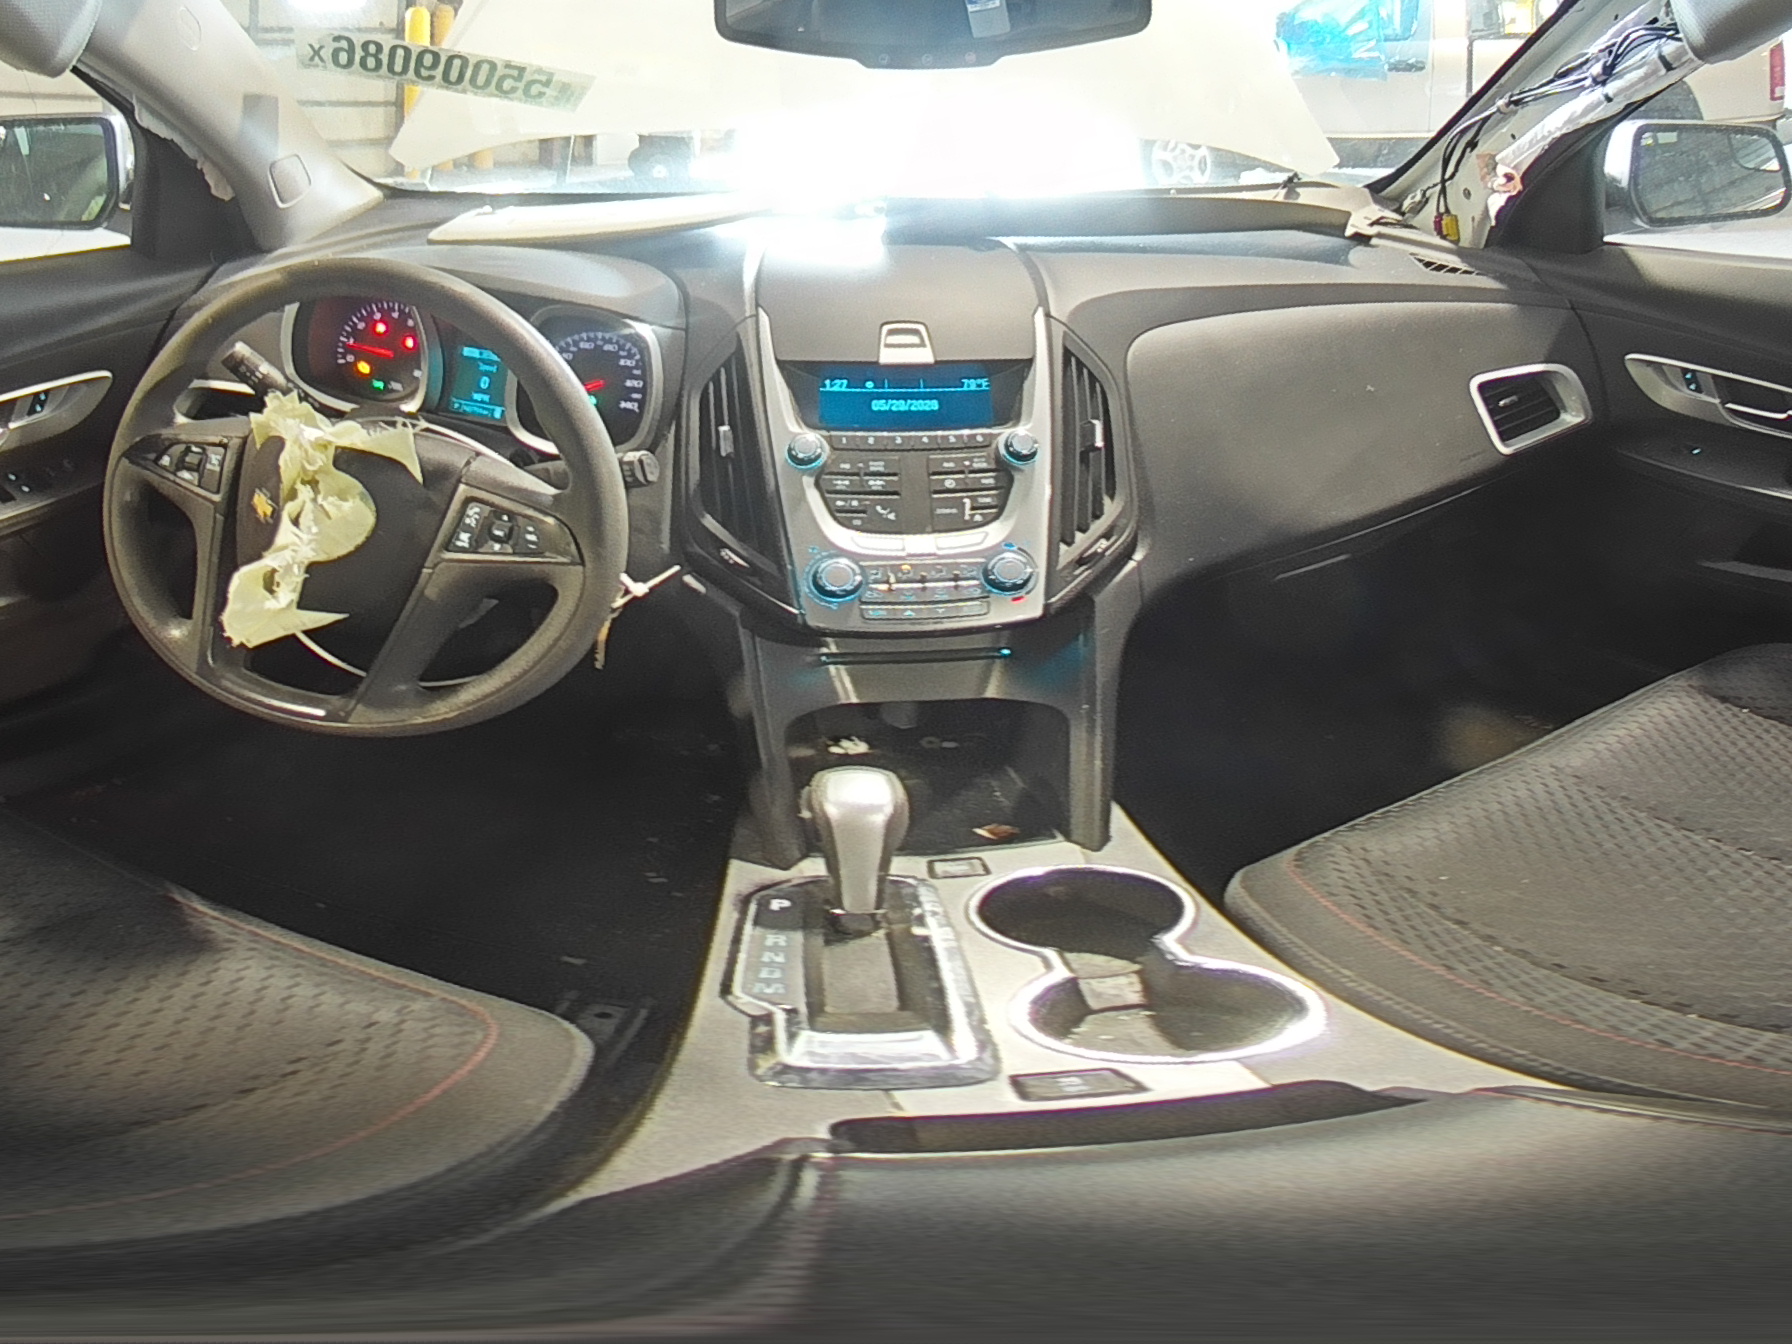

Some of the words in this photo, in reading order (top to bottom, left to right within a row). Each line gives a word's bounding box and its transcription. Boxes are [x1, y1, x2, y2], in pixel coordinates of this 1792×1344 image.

[480, 376, 490, 389] 0
[769, 898, 792, 911] P
[764, 934, 788, 946] R
[760, 951, 786, 963] N
[758, 967, 783, 979] D
